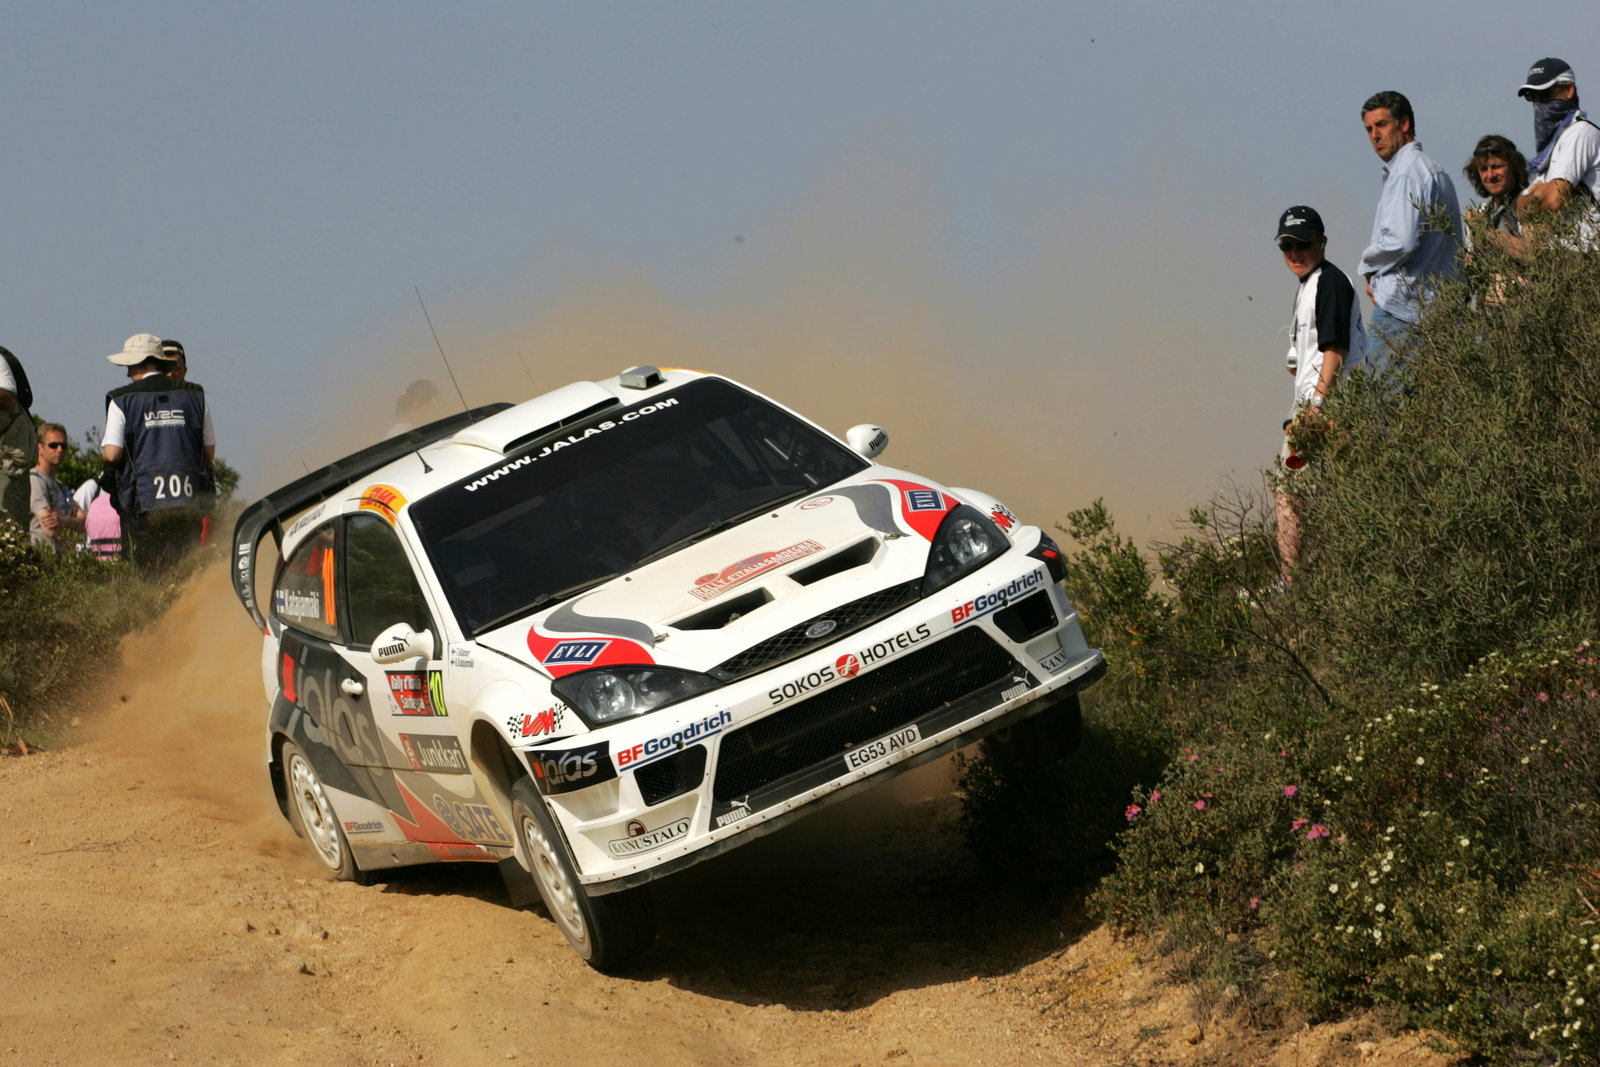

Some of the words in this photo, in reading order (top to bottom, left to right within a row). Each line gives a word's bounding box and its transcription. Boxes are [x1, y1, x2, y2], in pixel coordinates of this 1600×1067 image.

[144, 409, 185, 421] WRC
[464, 398, 680, 492] WWW.JALAS.COM
[153, 474, 193, 499] 206
[914, 491, 937, 508] EVLI
[694, 577, 729, 599] RALLY
[951, 569, 1044, 624] BFGoodrich
[378, 643, 405, 657] PUMA
[552, 645, 599, 659] EVLI
[768, 666, 835, 705] SOKOS
[860, 623, 931, 665] HOTELS
[429, 671, 447, 716] 10
[1000, 682, 1028, 702] PUMA
[521, 707, 556, 737] VM
[617, 710, 732, 766] BFGoodrich
[849, 741, 887, 768] EG53
[889, 728, 917, 751] AVD
[416, 739, 466, 768] Junkkari
[539, 751, 598, 794] jalas
[344, 820, 384, 831] BFGoodrich
[715, 806, 748, 828] PUMA
[611, 821, 689, 854] KANNUSTALO
